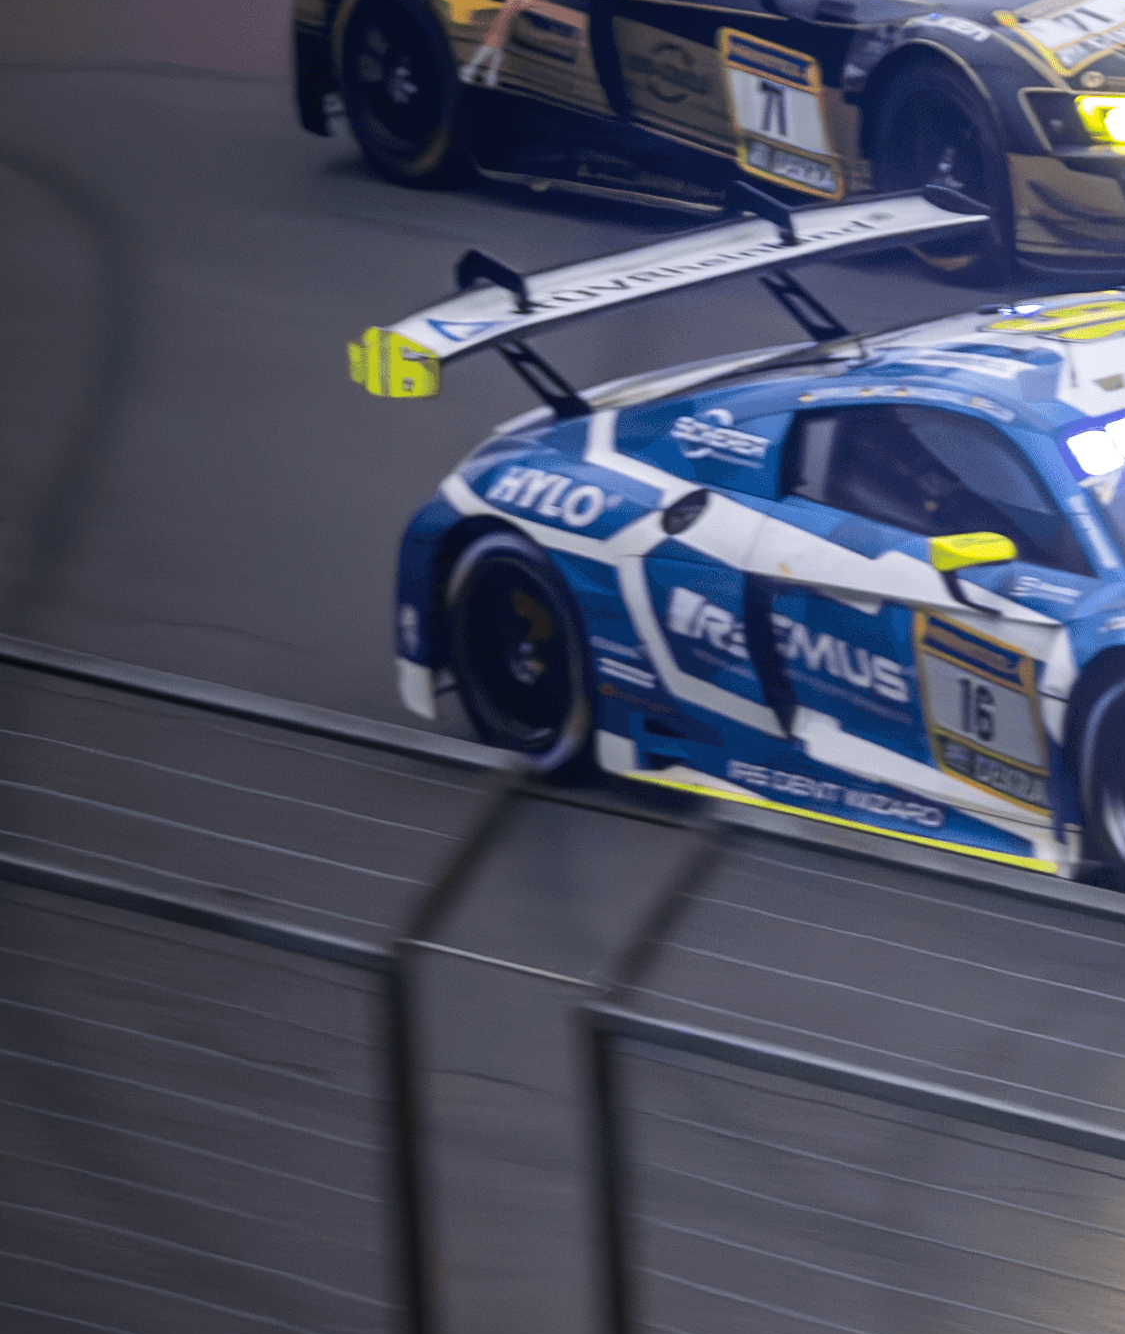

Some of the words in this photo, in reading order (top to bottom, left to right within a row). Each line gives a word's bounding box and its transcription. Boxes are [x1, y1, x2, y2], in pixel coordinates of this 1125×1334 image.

[761, 81, 788, 127] 71
[484, 466, 606, 528] HYLO
[698, 600, 911, 704] REMUS
[959, 677, 997, 743] 16
